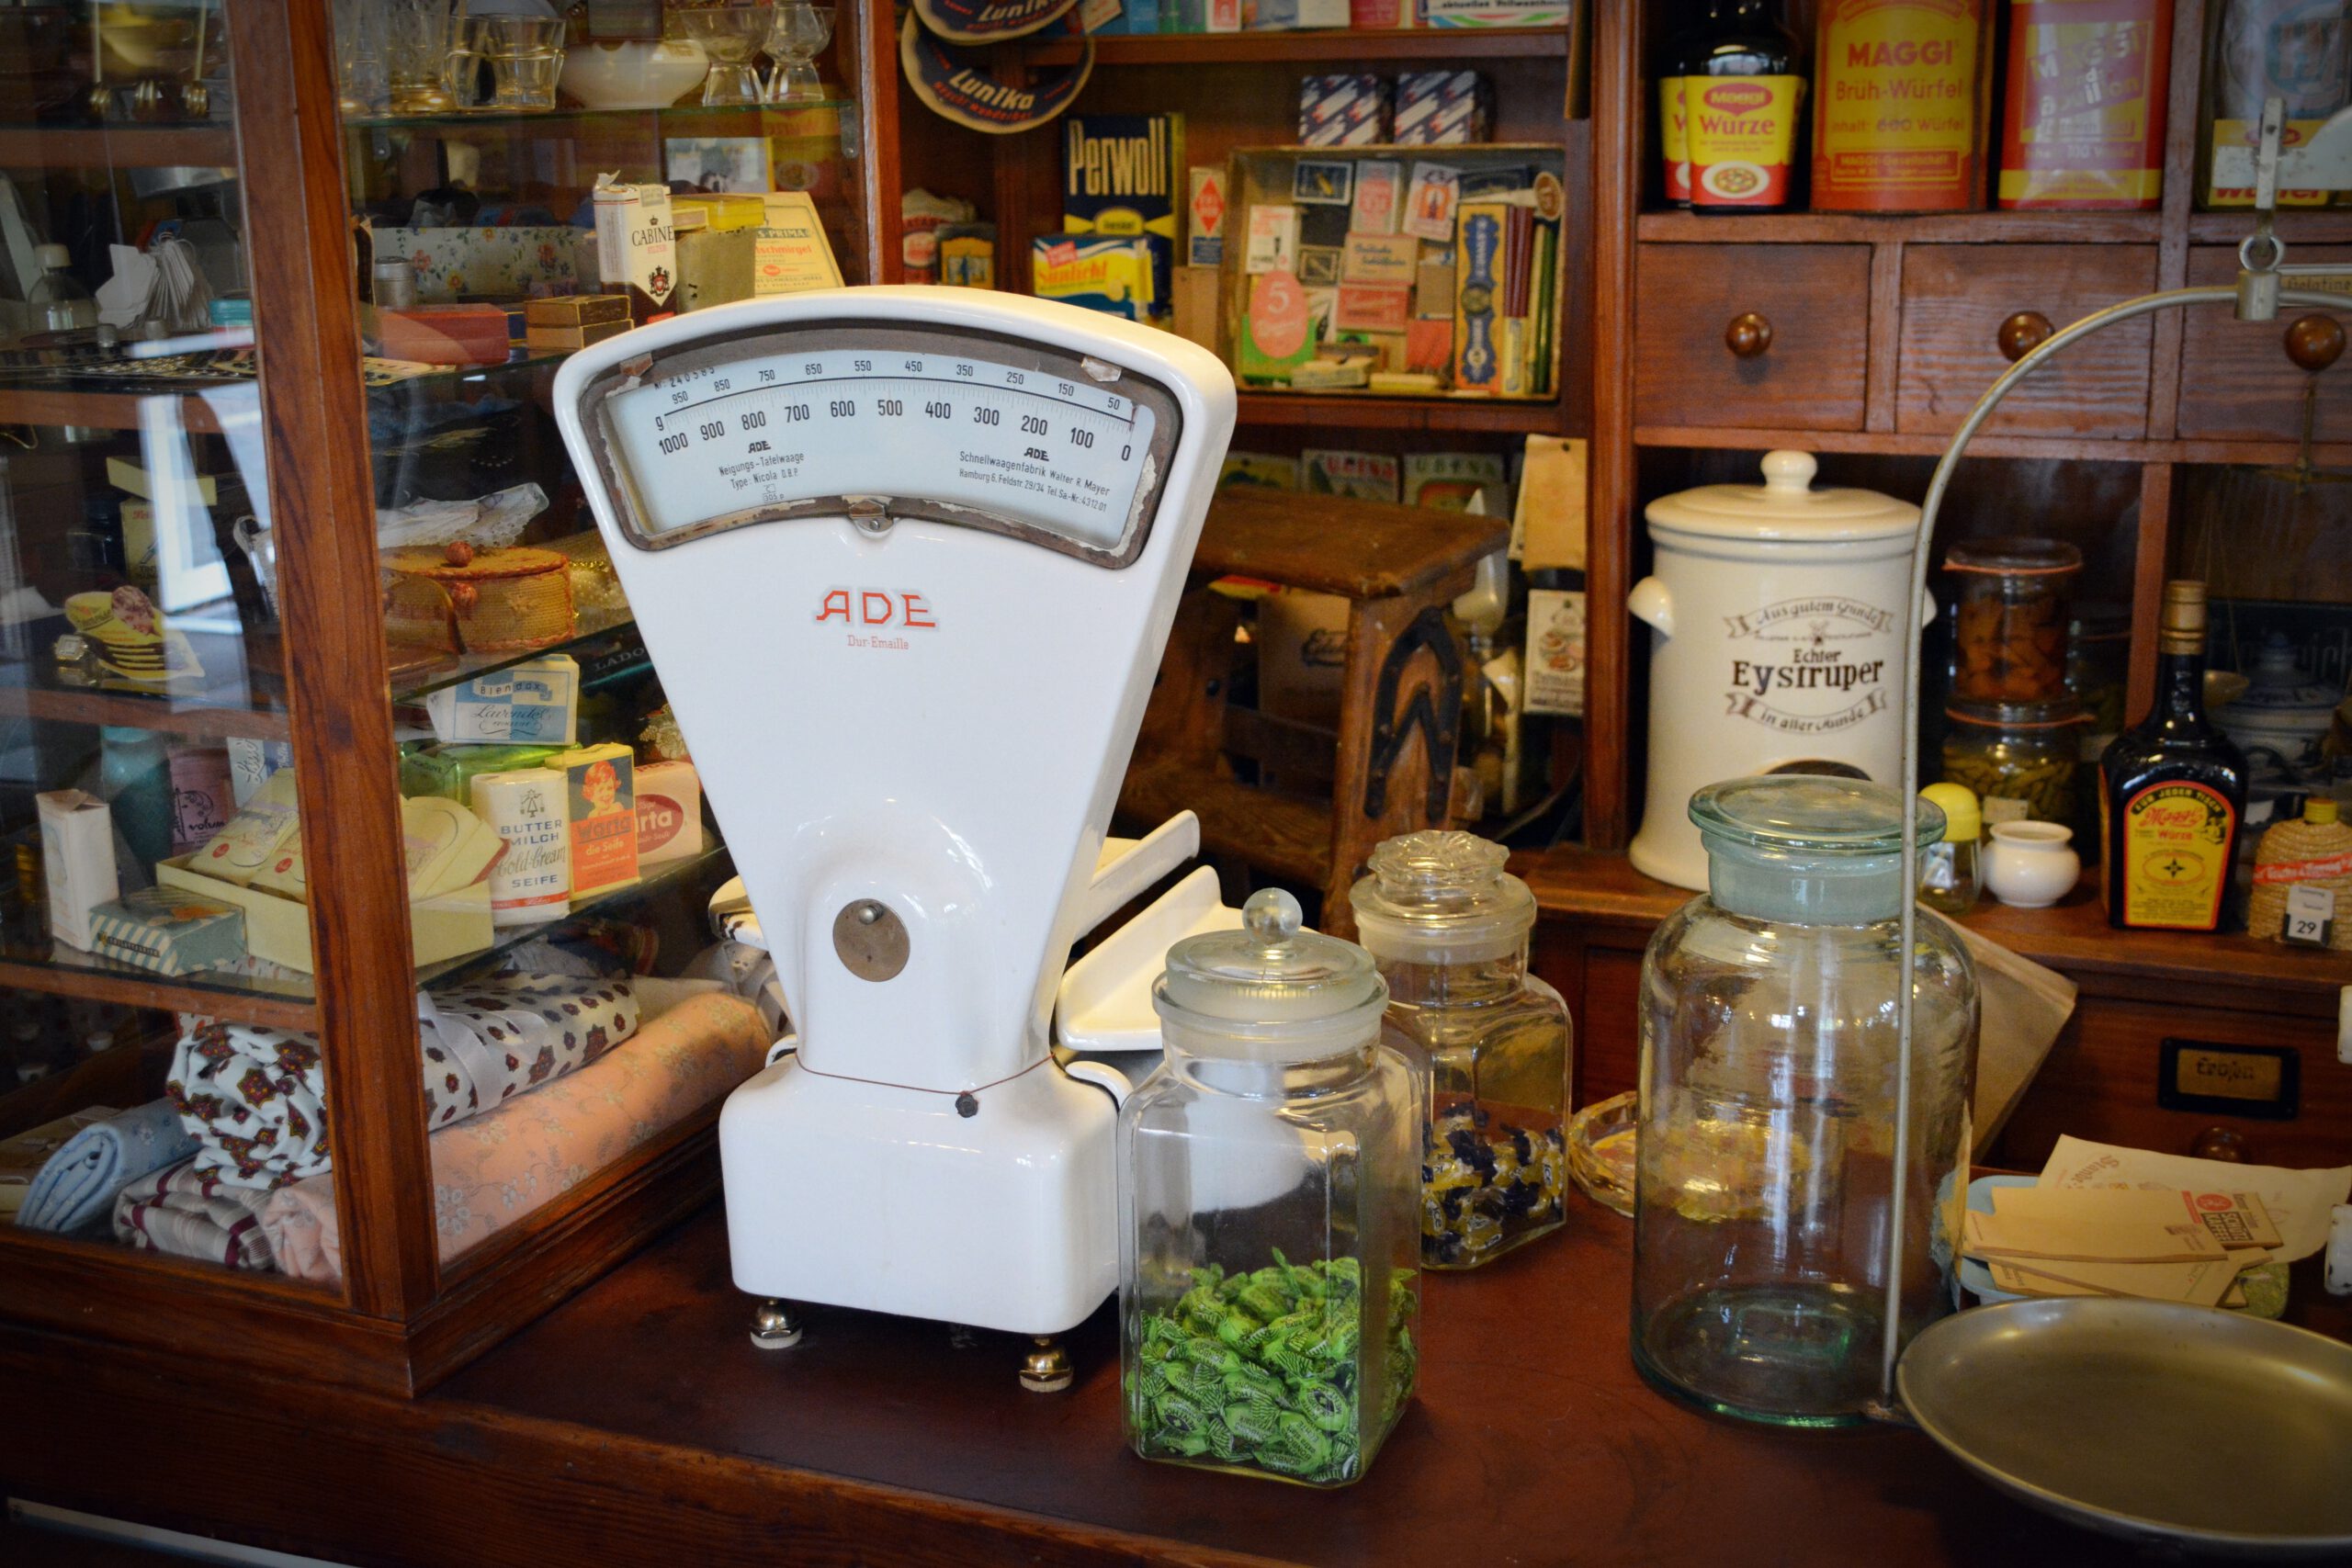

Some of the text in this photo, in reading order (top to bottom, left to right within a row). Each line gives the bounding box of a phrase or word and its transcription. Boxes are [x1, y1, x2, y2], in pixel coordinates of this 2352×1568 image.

[1847, 40, 1953, 69] MAGGI
[1068, 117, 1167, 197] Perwoll
[672, 360, 1120, 411] 950 850 750 650 550 450 350 250 150 50
[654, 416, 664, 432] g
[659, 400, 1131, 461] 1000 900 800 700 600 500 400 300 200 100 0
[748, 440, 772, 454] ADE
[1023, 446, 1050, 462] ADE
[959, 451, 1046, 478] Schnellwaagenfabrik
[1049, 469, 1074, 485] Walter
[1084, 479, 1110, 497] Mayer
[816, 590, 936, 628] ADE
[847, 634, 910, 650] Dur-Emaille
[1793, 648, 1841, 664] Echter
[1733, 660, 1884, 696] Eystruper
[480, 681, 541, 696] Blendax
[501, 818, 562, 835] BUTTER
[511, 832, 560, 846] MILCH
[512, 874, 558, 888] SEIFE
[2297, 919, 2317, 935] 29
